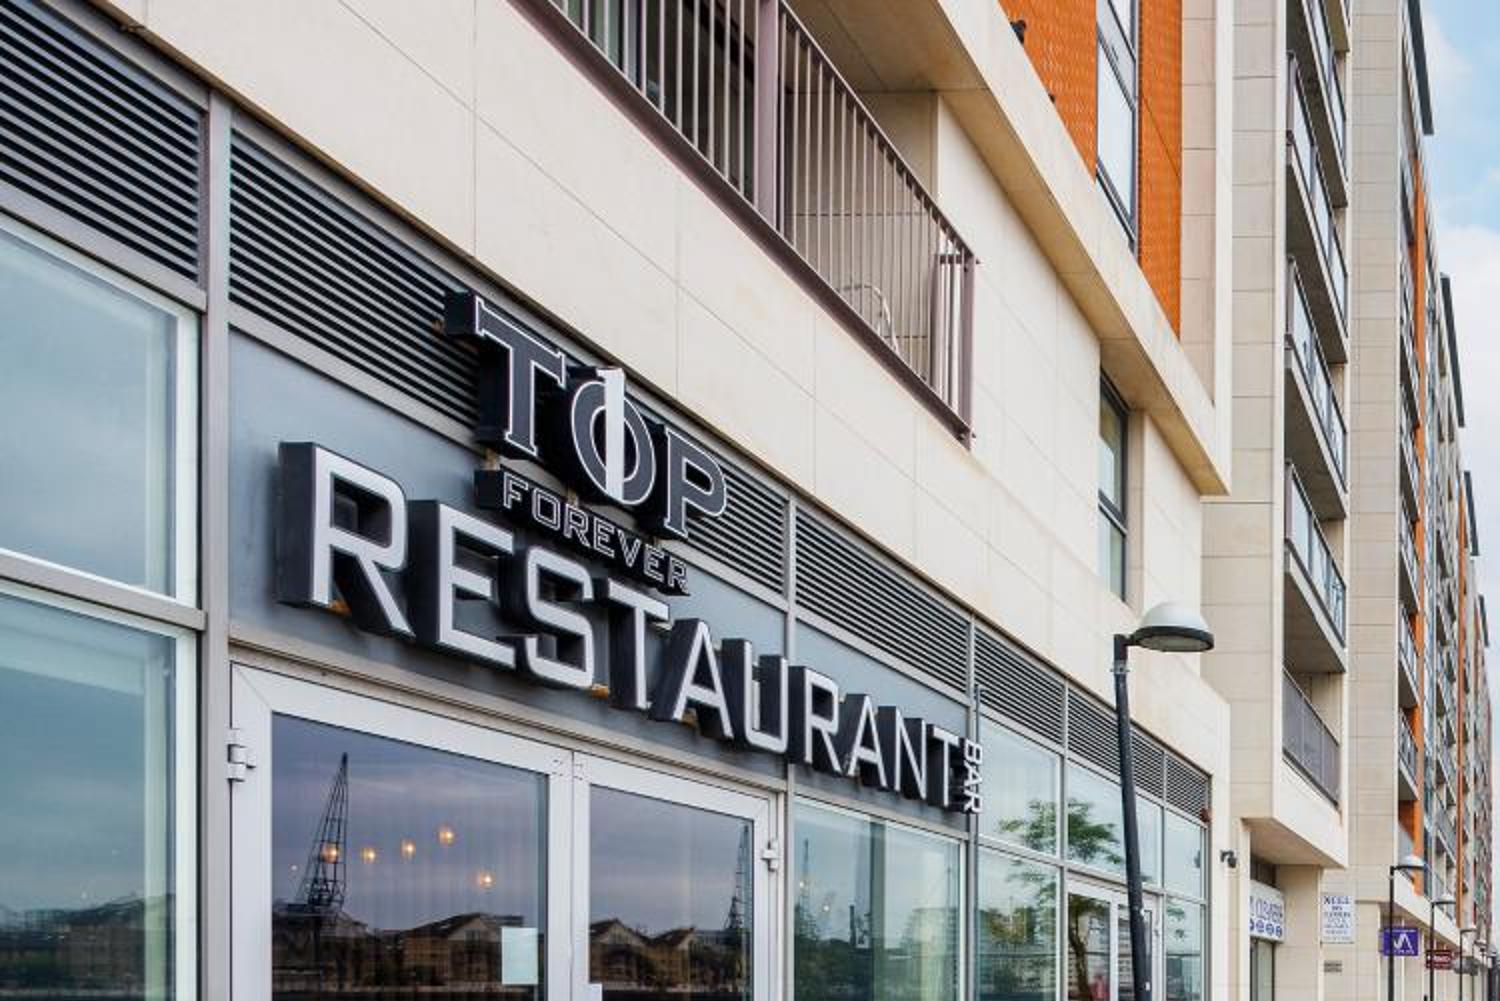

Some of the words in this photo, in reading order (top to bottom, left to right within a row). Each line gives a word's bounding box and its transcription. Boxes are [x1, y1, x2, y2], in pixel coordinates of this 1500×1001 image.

[473, 294, 728, 539] TOP
[501, 472, 690, 593] FOREVER
[305, 446, 959, 809] RESTAURANT
[963, 738, 983, 814] BAR
